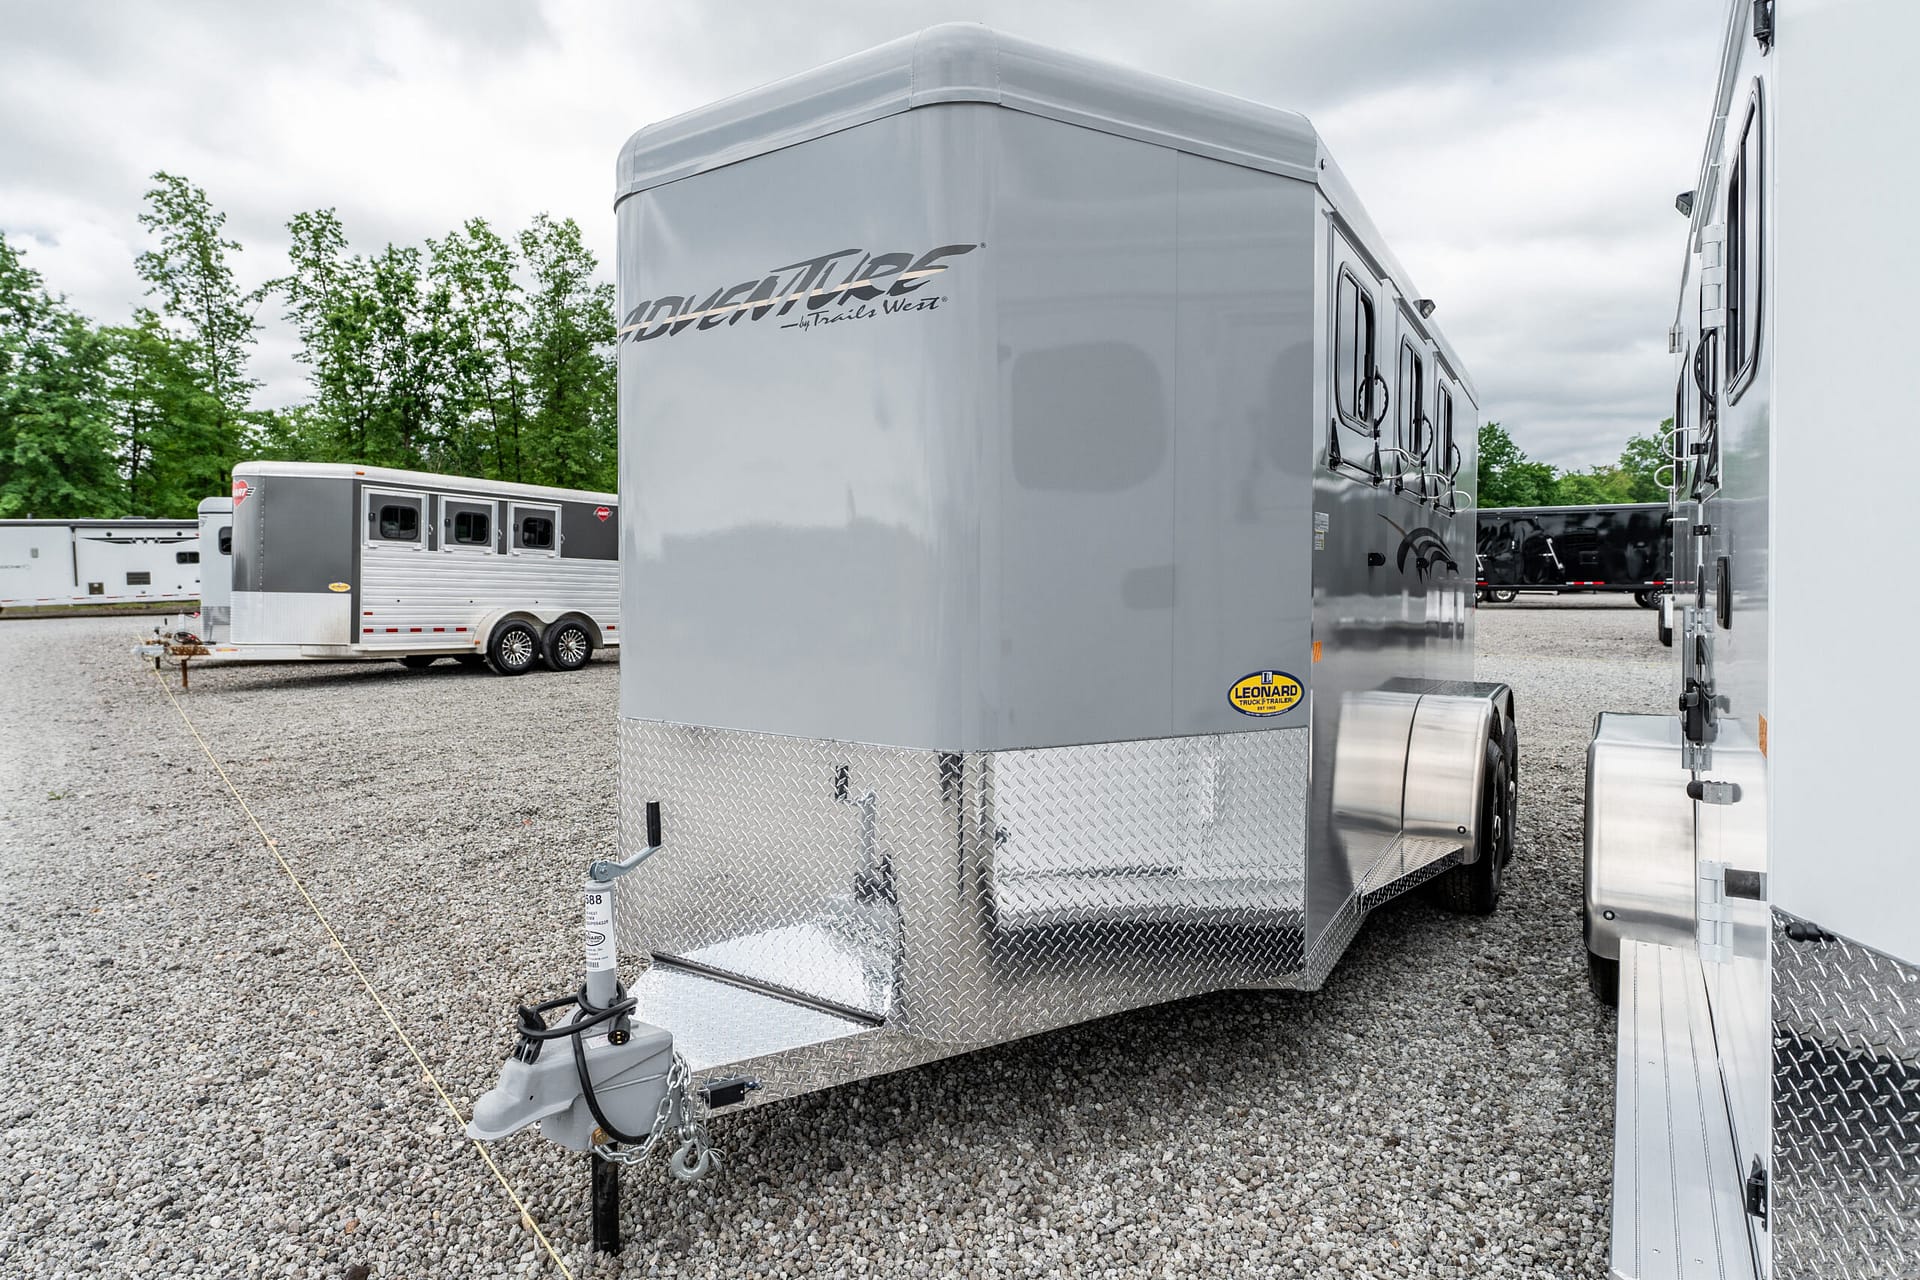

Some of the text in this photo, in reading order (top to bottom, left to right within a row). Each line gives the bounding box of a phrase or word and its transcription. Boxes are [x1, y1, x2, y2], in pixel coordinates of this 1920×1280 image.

[618, 244, 978, 344] ADVENTURE
[807, 304, 877, 327] Trails
[883, 296, 940, 315] West
[1235, 685, 1297, 698] LEONARD
